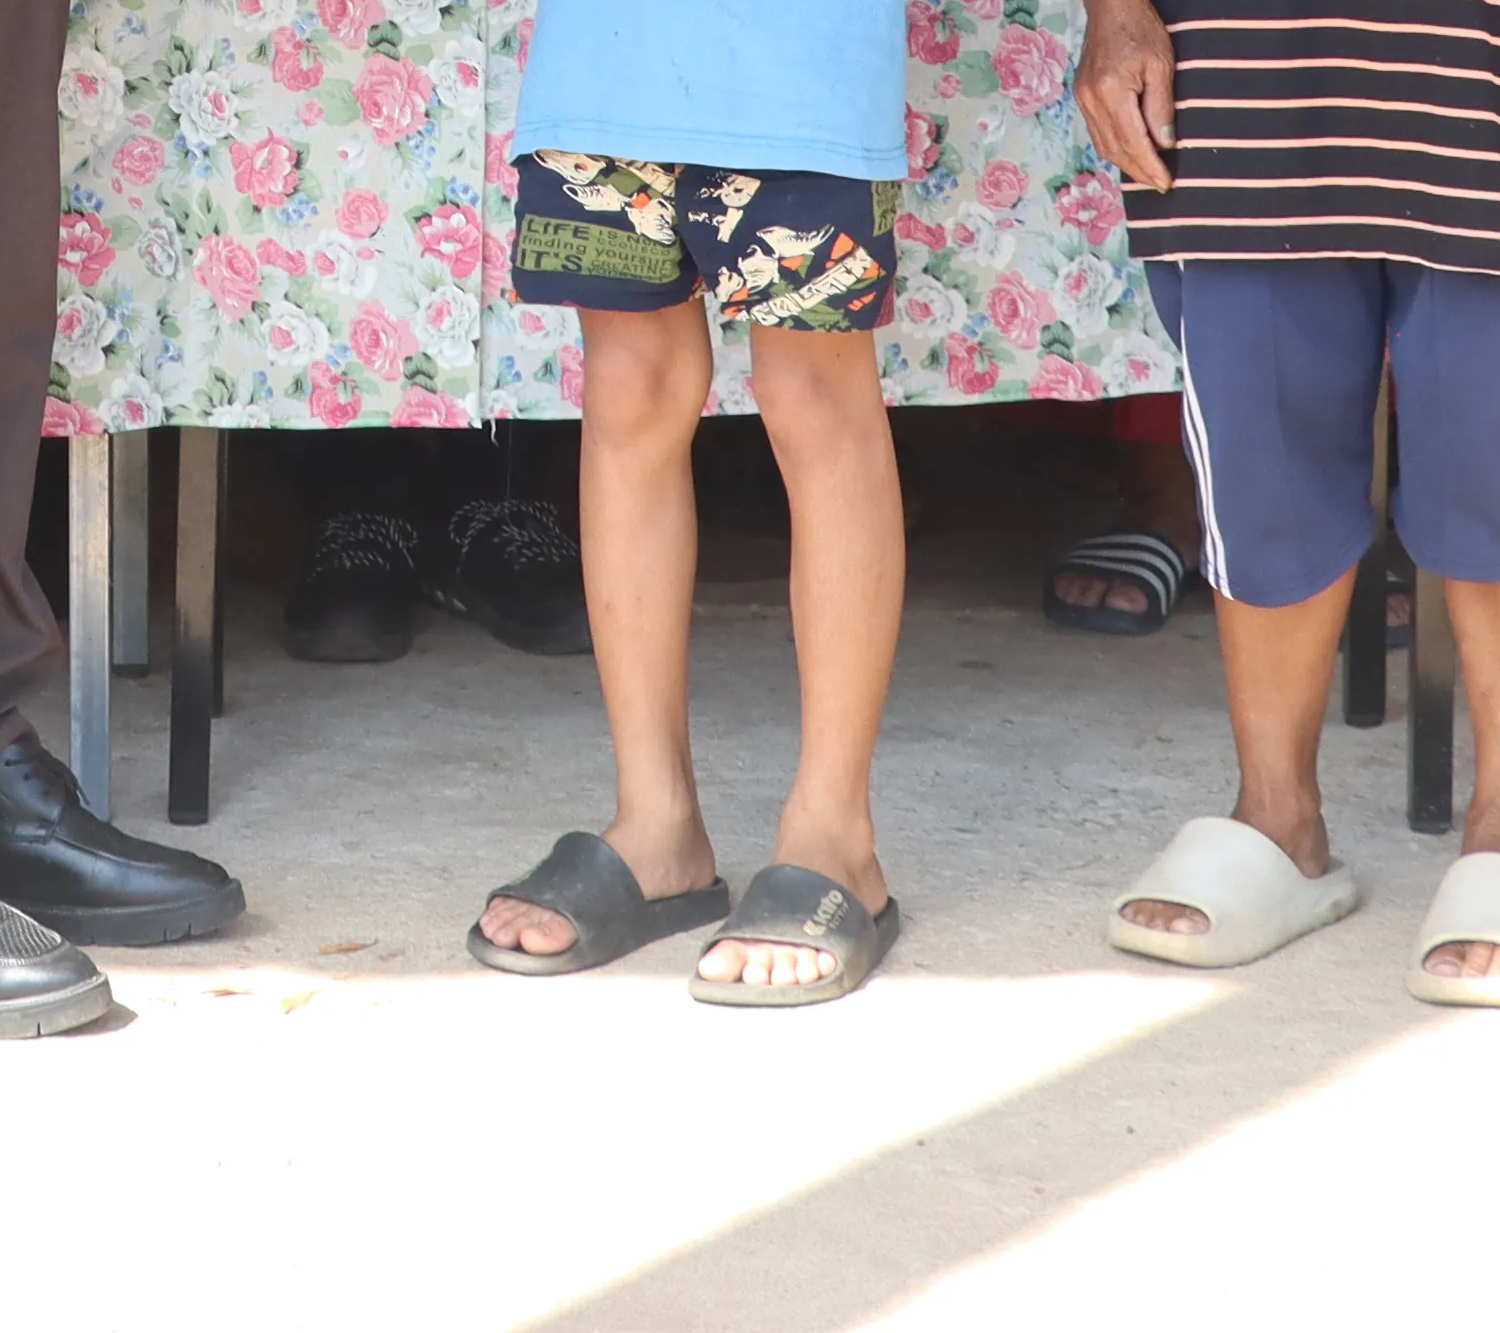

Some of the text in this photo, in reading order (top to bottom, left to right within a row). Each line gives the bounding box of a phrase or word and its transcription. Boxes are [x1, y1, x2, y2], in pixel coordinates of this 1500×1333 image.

[526, 217, 591, 242] LIFE
[522, 233, 588, 256] finding
[520, 248, 584, 273] IT'S
